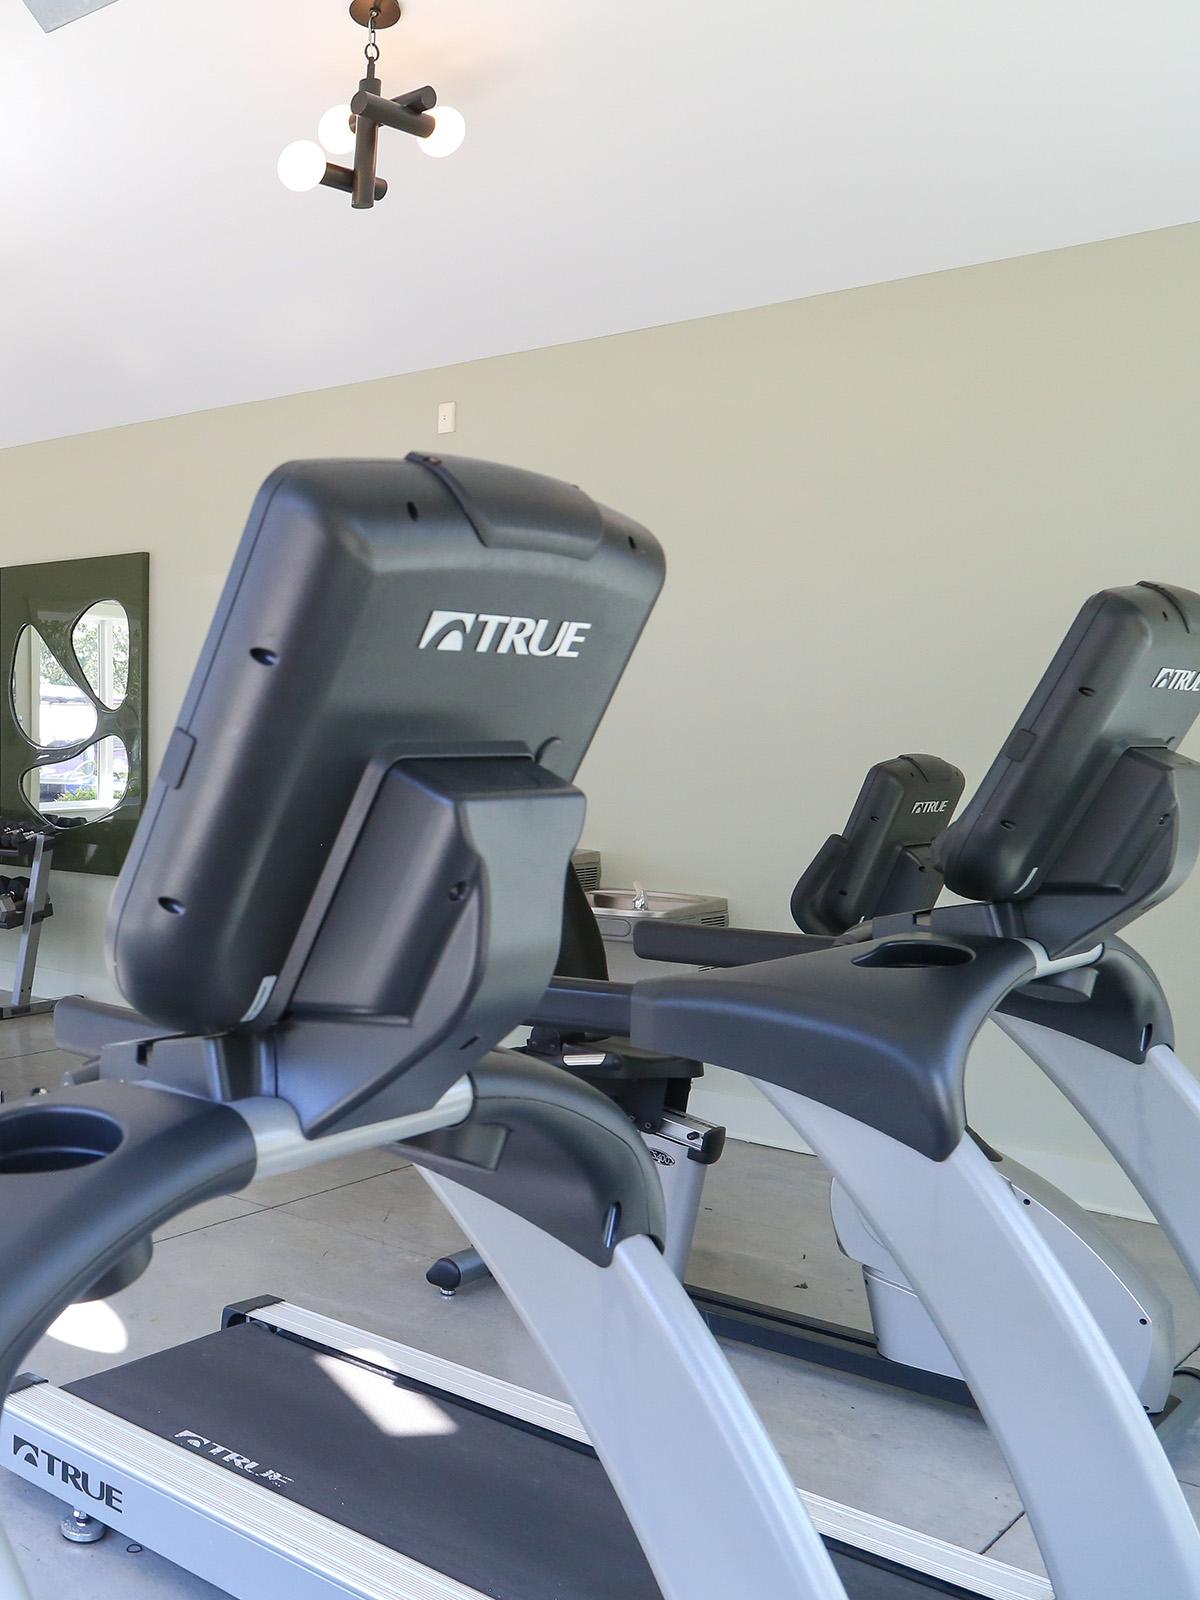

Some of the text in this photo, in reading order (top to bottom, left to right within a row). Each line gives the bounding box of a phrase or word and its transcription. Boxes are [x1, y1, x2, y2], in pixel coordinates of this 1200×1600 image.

[475, 613, 592, 658] TRUE
[922, 801, 949, 813] TRUE
[41, 1449, 123, 1514] TRUE
[208, 1442, 295, 1487] TRUE
